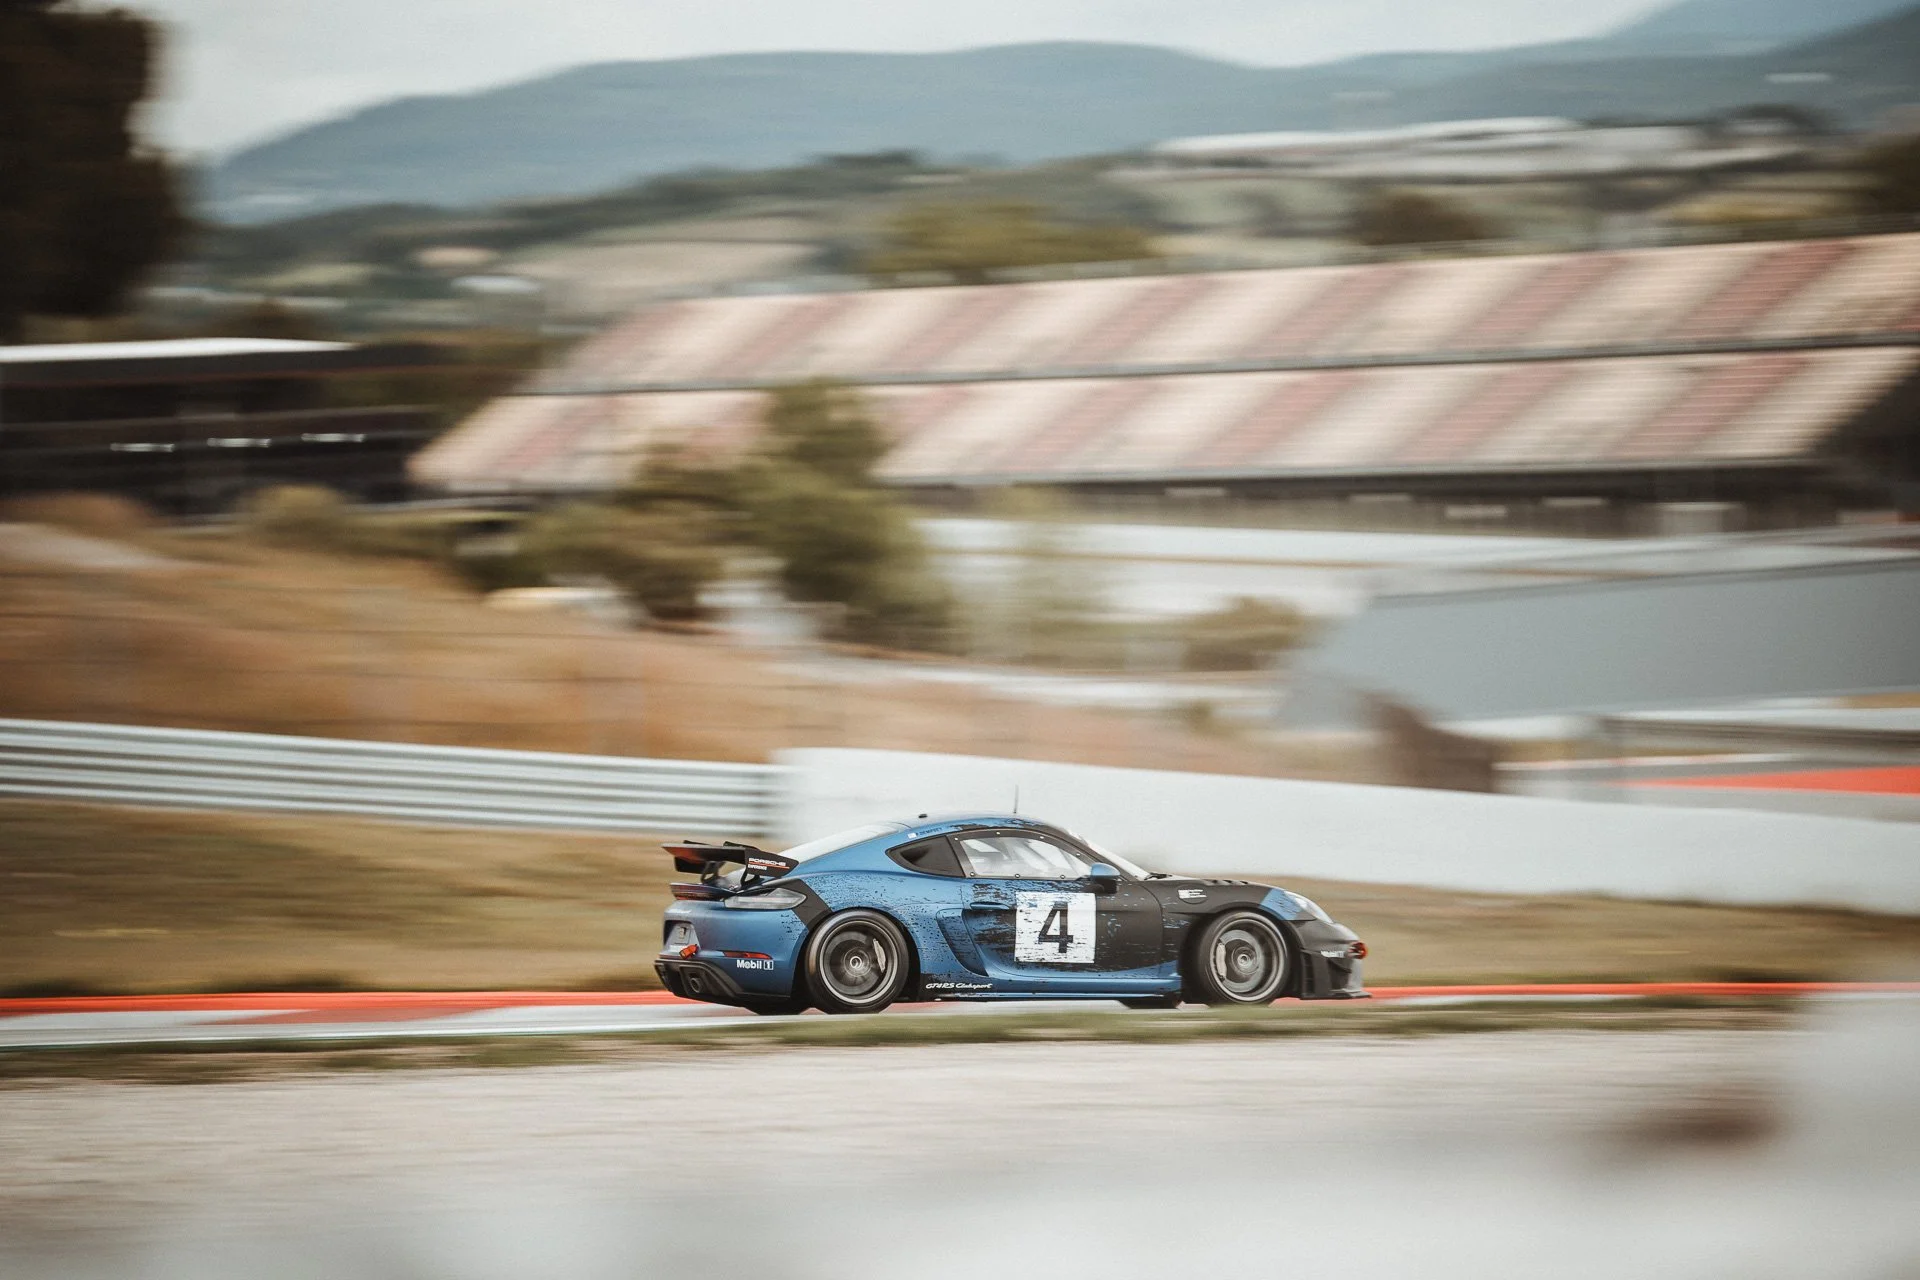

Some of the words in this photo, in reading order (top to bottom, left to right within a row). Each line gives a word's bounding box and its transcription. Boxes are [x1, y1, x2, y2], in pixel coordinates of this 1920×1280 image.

[748, 857, 786, 866] PORSCHE
[1038, 901, 1074, 953] 4
[736, 959, 762, 969] Mobil
